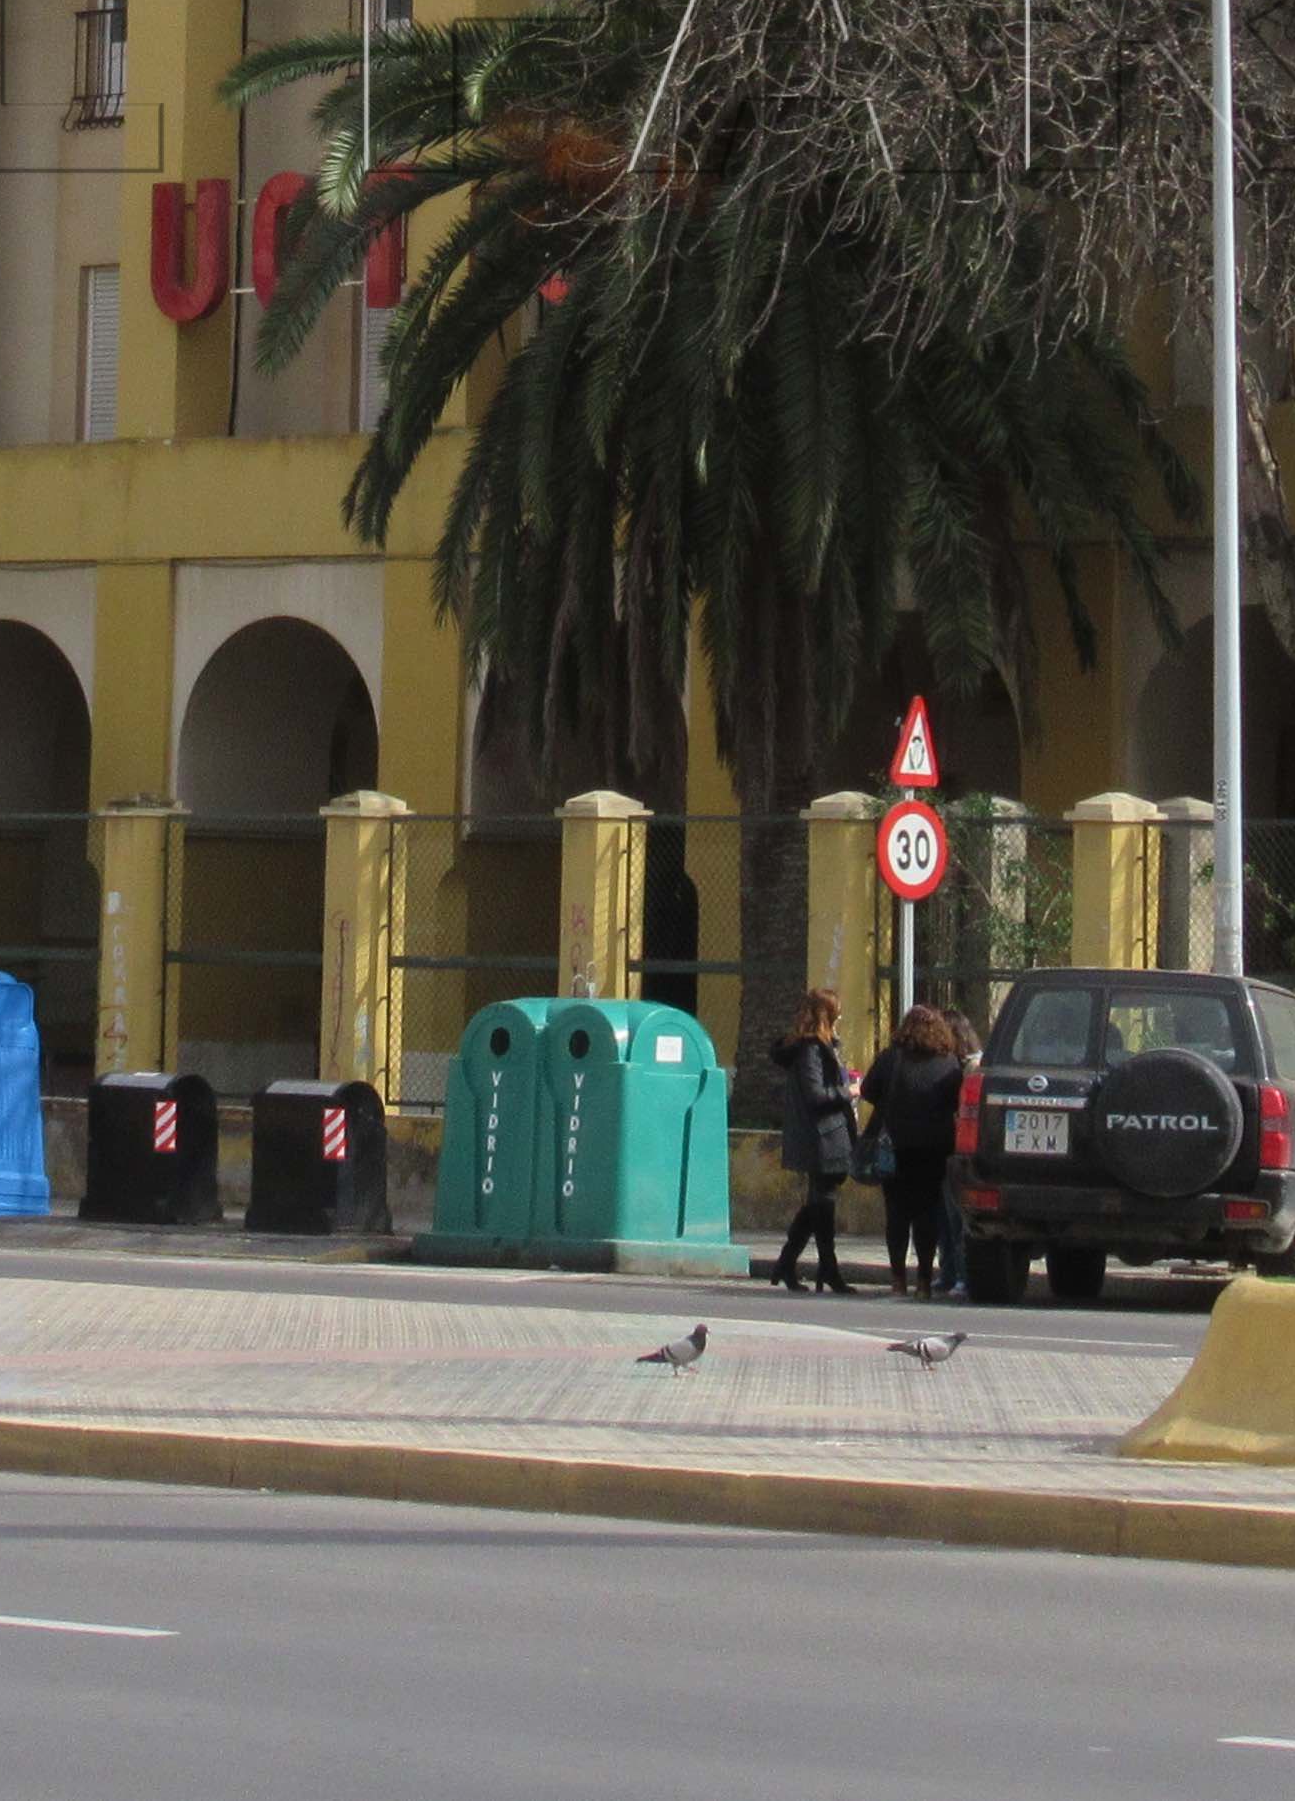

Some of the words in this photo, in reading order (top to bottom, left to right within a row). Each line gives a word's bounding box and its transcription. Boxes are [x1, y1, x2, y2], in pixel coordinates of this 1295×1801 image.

[896, 828, 931, 871] 30
[481, 1071, 503, 1195] VIDRIO
[562, 1073, 585, 1197] VIDRIO
[1017, 1113, 1063, 1130] 2017
[1106, 1113, 1218, 1131] PATROL
